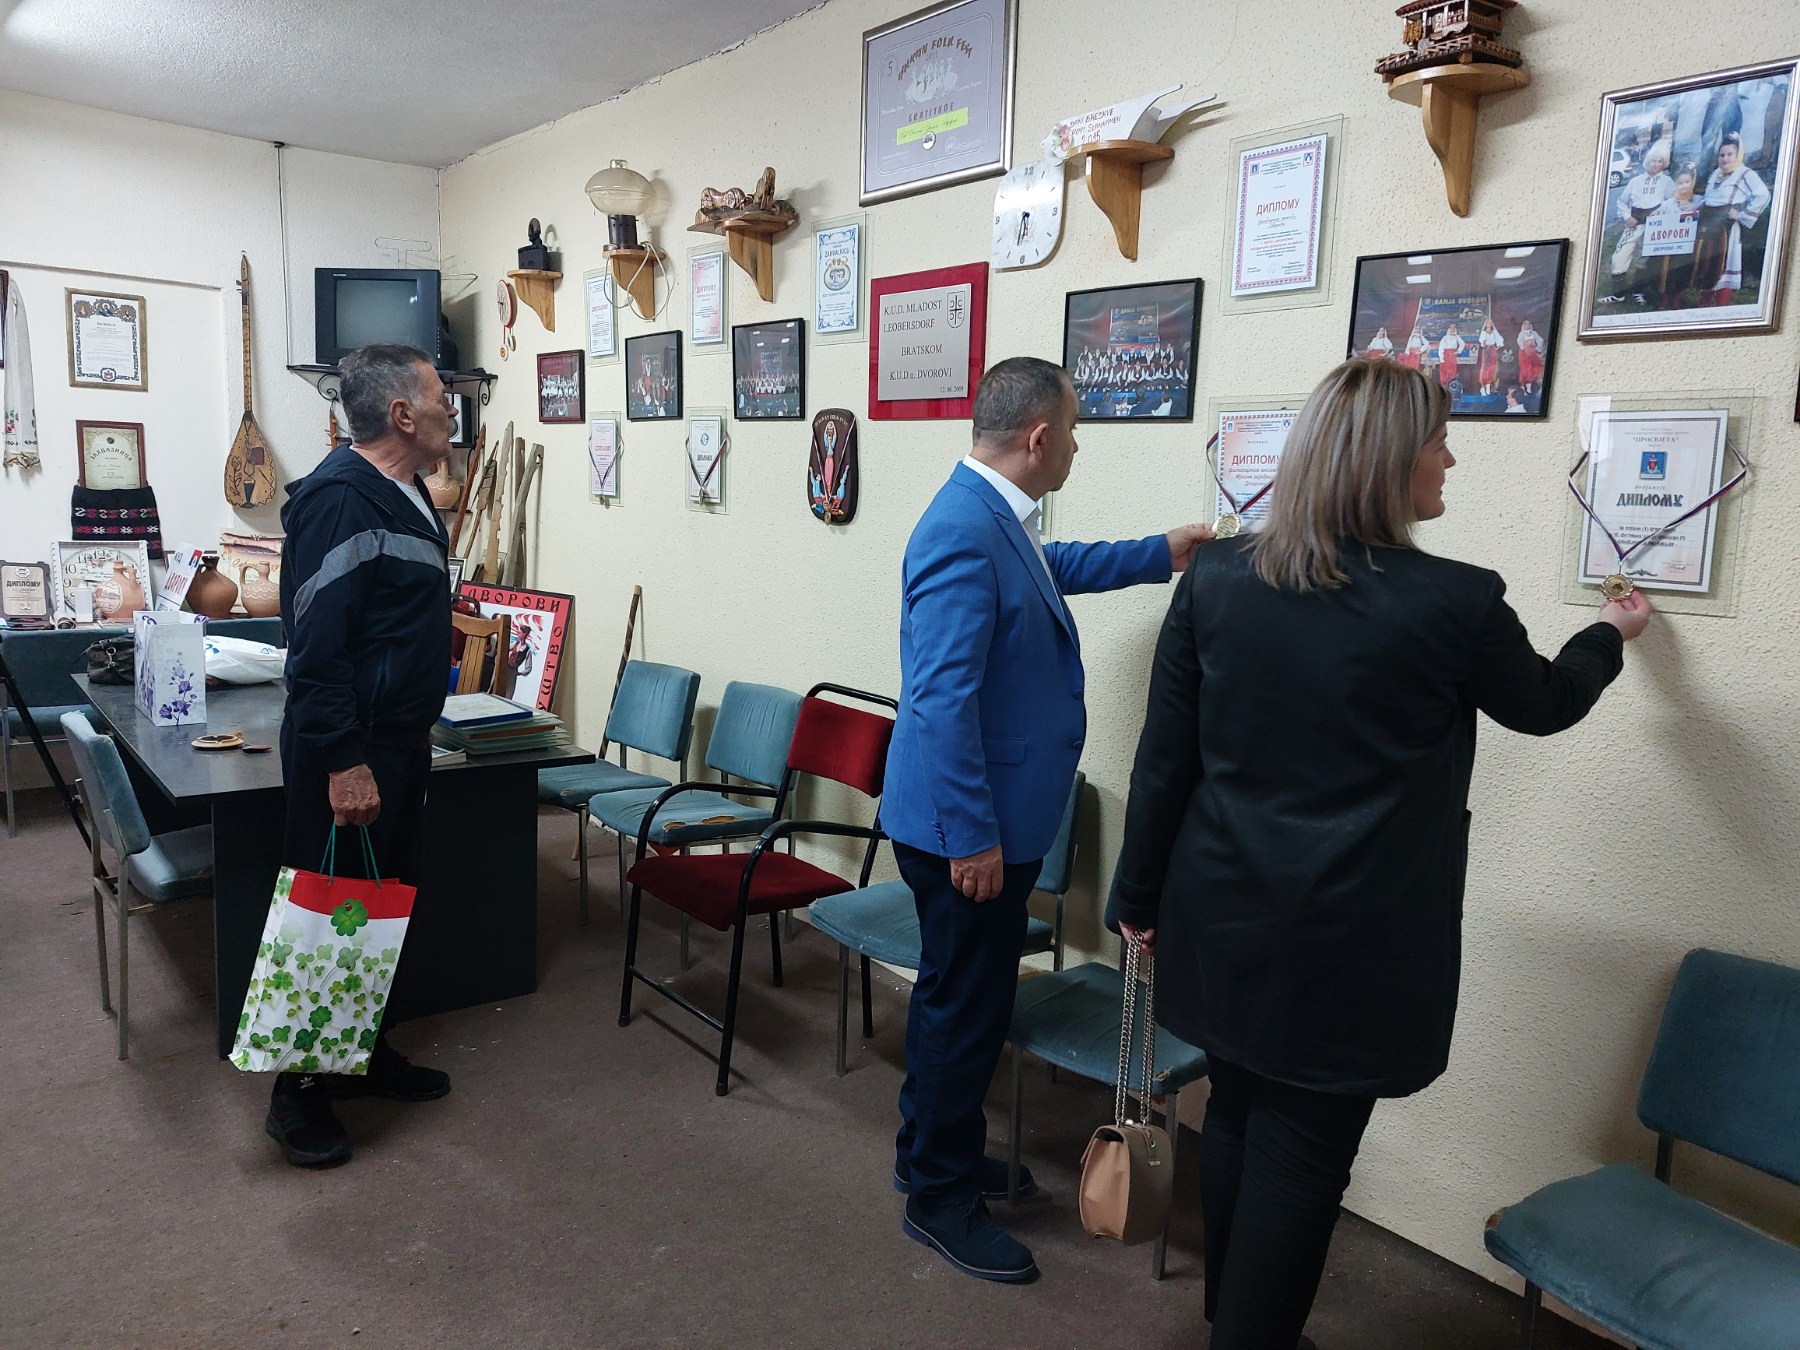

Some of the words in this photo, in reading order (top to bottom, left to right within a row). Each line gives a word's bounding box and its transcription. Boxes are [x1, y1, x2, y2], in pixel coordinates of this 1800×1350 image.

[931, 36, 955, 51] FOLK
[955, 37, 973, 58] FEST
[1024, 166, 1034, 176] 12
[1052, 206, 1059, 217] 3
[1256, 197, 1300, 217] ДИПЛОМУ
[995, 215, 1001, 225] 9
[1650, 228, 1690, 241] ДВОРОВИ
[1019, 254, 1026, 265] 6
[884, 304, 905, 316] K.U.D.
[906, 300, 943, 314] MLADOST
[883, 318, 935, 333] LEOBERSDORF
[901, 344, 943, 356] BRATSKOM
[917, 367, 952, 379] DVOROVI
[78, 552, 88, 564] 11
[93, 550, 106, 560] 12
[65, 563, 77, 575] 10
[6, 580, 41, 588] ДИПЛОМУ
[63, 577, 72, 589] 9
[468, 588, 561, 613] ДВОРОВИ
[537, 625, 563, 711] УШТВО
